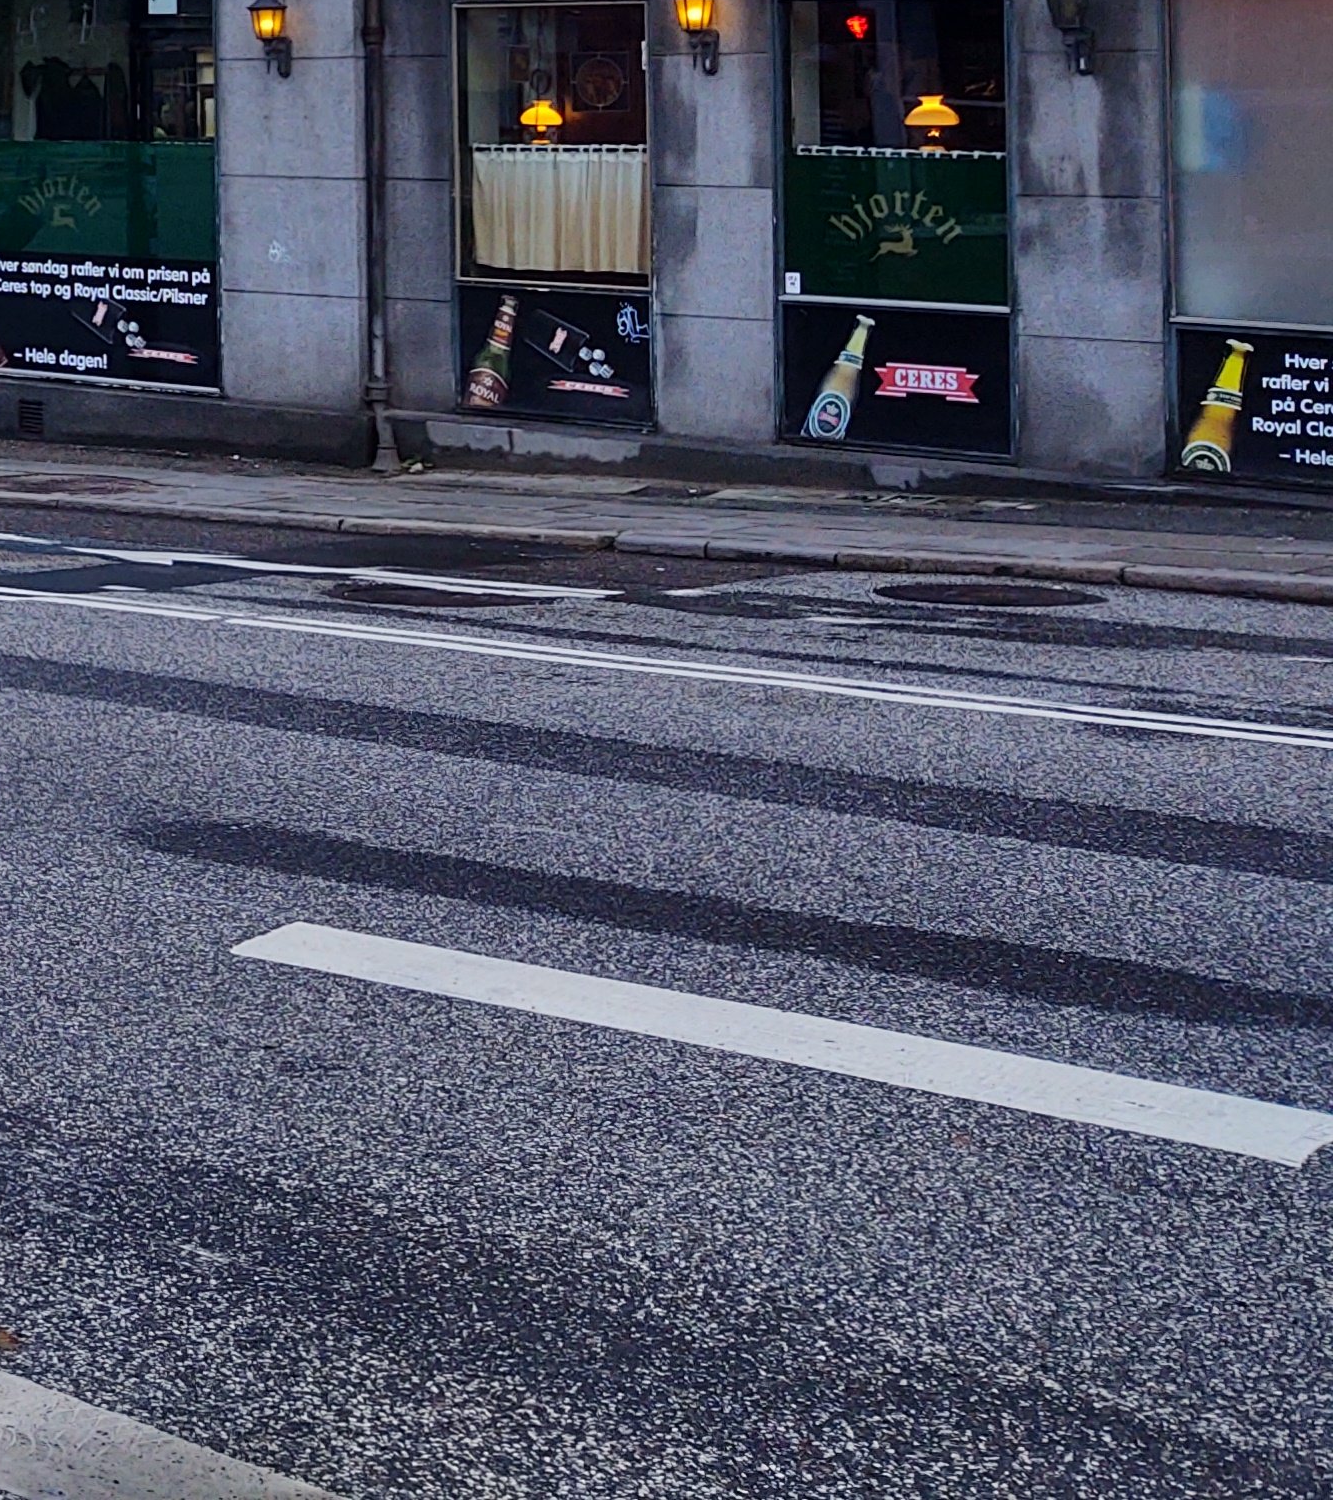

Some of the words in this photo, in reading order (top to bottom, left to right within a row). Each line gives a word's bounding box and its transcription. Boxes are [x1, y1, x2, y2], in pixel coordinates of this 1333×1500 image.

[21, 259, 68, 279] søndag
[71, 262, 106, 278] rafler
[108, 263, 120, 279] vi
[122, 267, 145, 280] om
[147, 265, 189, 284] prisen
[191, 267, 211, 286] på
[30, 279, 50, 299] top
[54, 284, 72, 300] og
[74, 283, 110, 303] Royal
[112, 283, 209, 306] Classic/Pilsner
[25, 348, 55, 365] Hele
[59, 349, 108, 370] dagen!
[1284, 353, 1328, 370] Hver
[894, 367, 959, 390] CERES
[1262, 374, 1310, 391] rafler
[1313, 377, 1329, 393] vi
[1271, 396, 1295, 414] på
[1252, 417, 1301, 437] Royal
[1306, 421, 1333, 438] Cla
